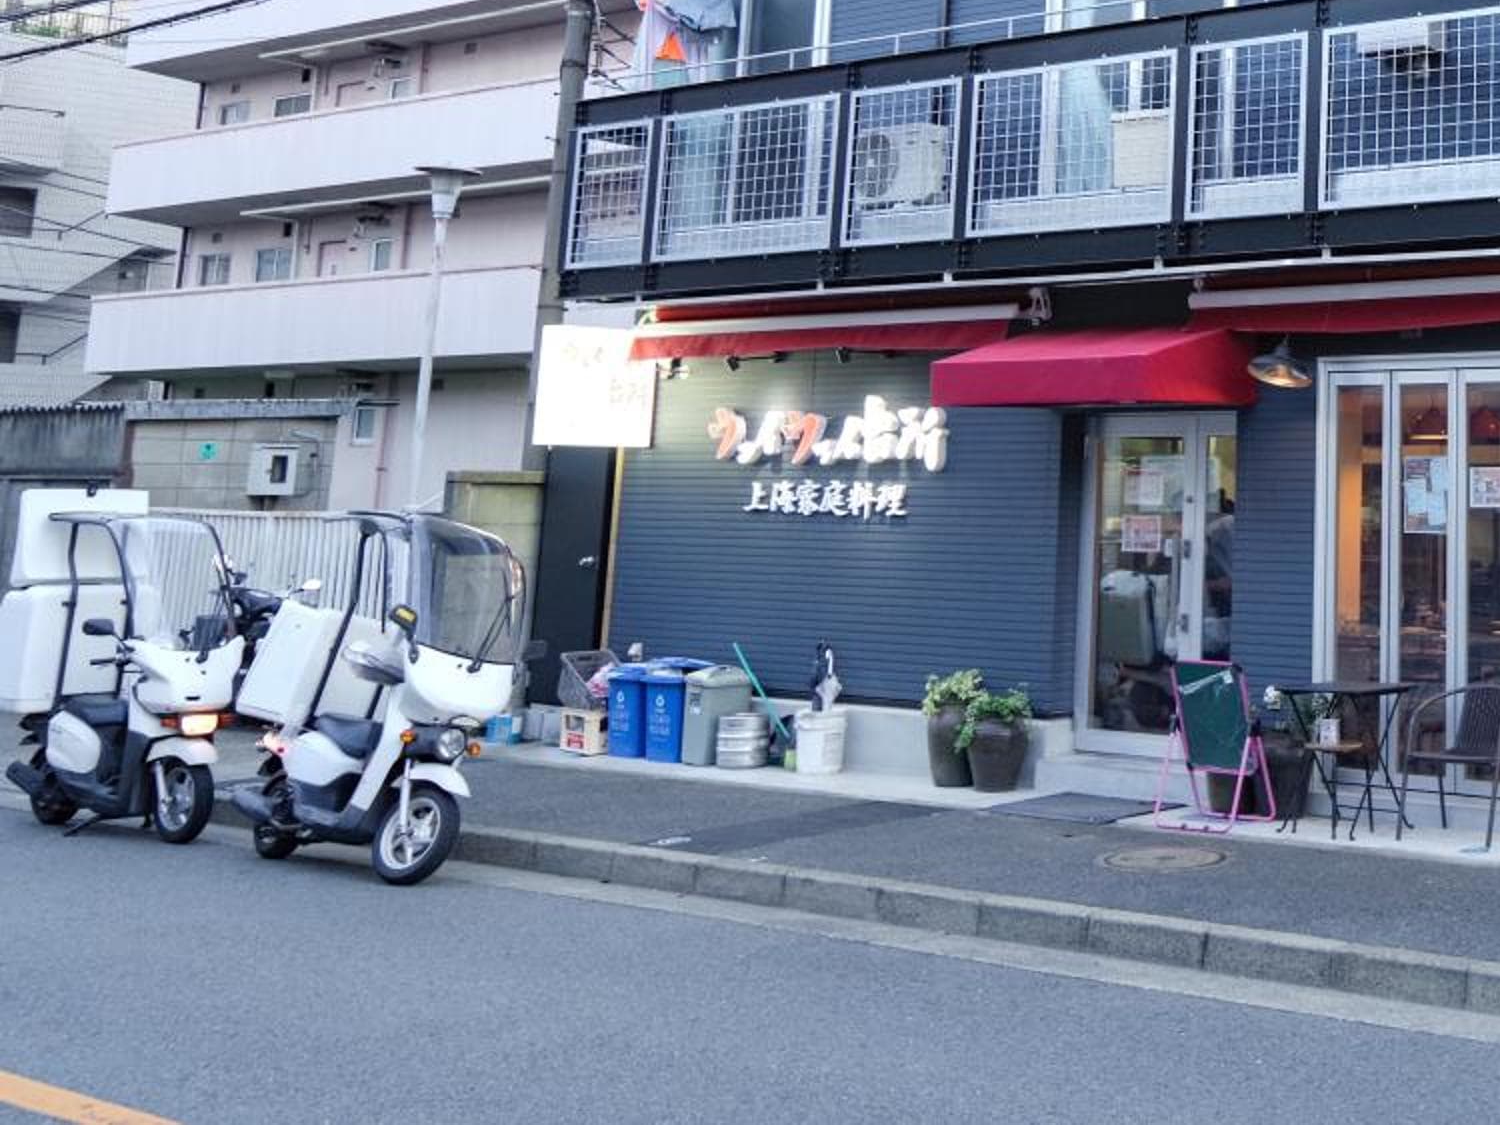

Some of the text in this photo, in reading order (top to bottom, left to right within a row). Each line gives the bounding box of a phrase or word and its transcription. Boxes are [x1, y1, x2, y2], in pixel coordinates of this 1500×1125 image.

[743, 479, 908, 520] 上海家庭料理
